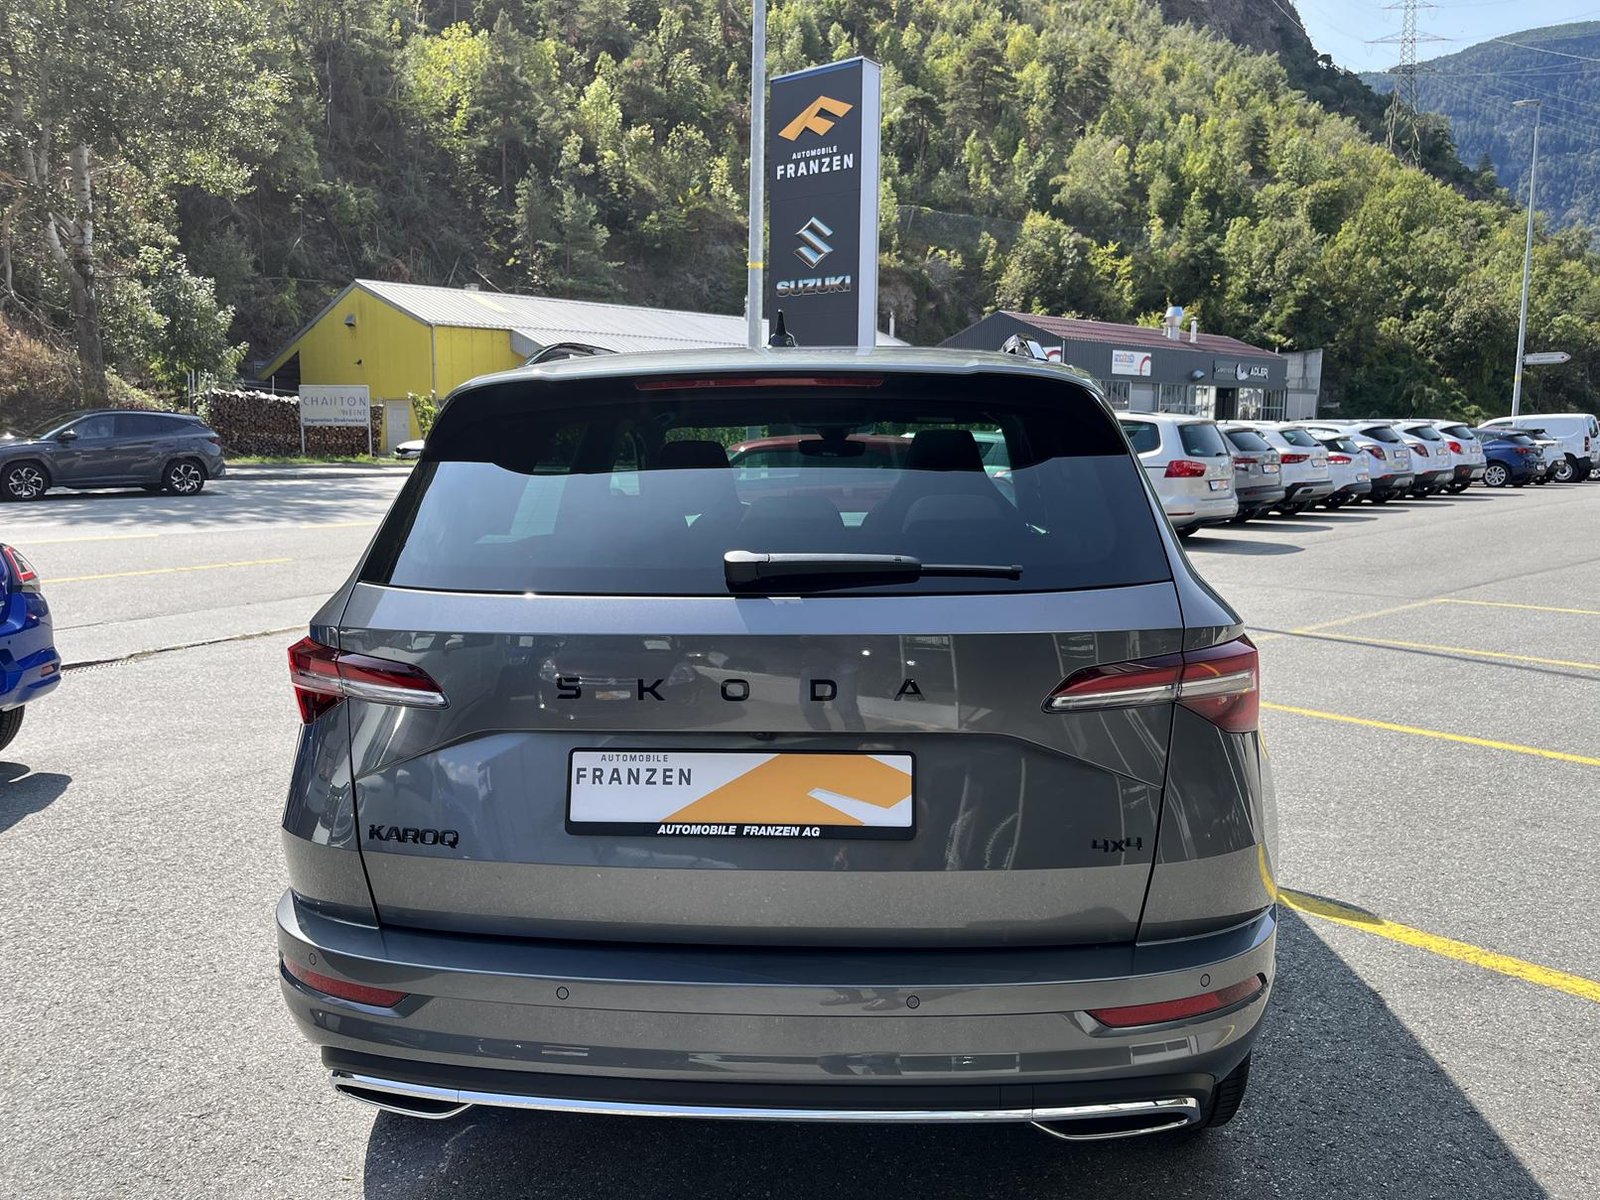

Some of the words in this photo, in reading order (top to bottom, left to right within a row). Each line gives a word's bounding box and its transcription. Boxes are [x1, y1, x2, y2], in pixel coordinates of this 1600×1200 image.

[792, 145, 838, 160] AUTOMOBILE
[776, 153, 854, 180] FRANZEN
[776, 275, 852, 297] SUZUKI
[556, 677, 926, 702] SKODA
[600, 753, 669, 763] AUTOMOBILE
[576, 767, 693, 786] FRANZEN
[368, 824, 459, 849] KAROQ
[656, 824, 737, 835] AUTOMOBILE
[742, 825, 800, 837] FRANZEN
[801, 826, 821, 837] AG
